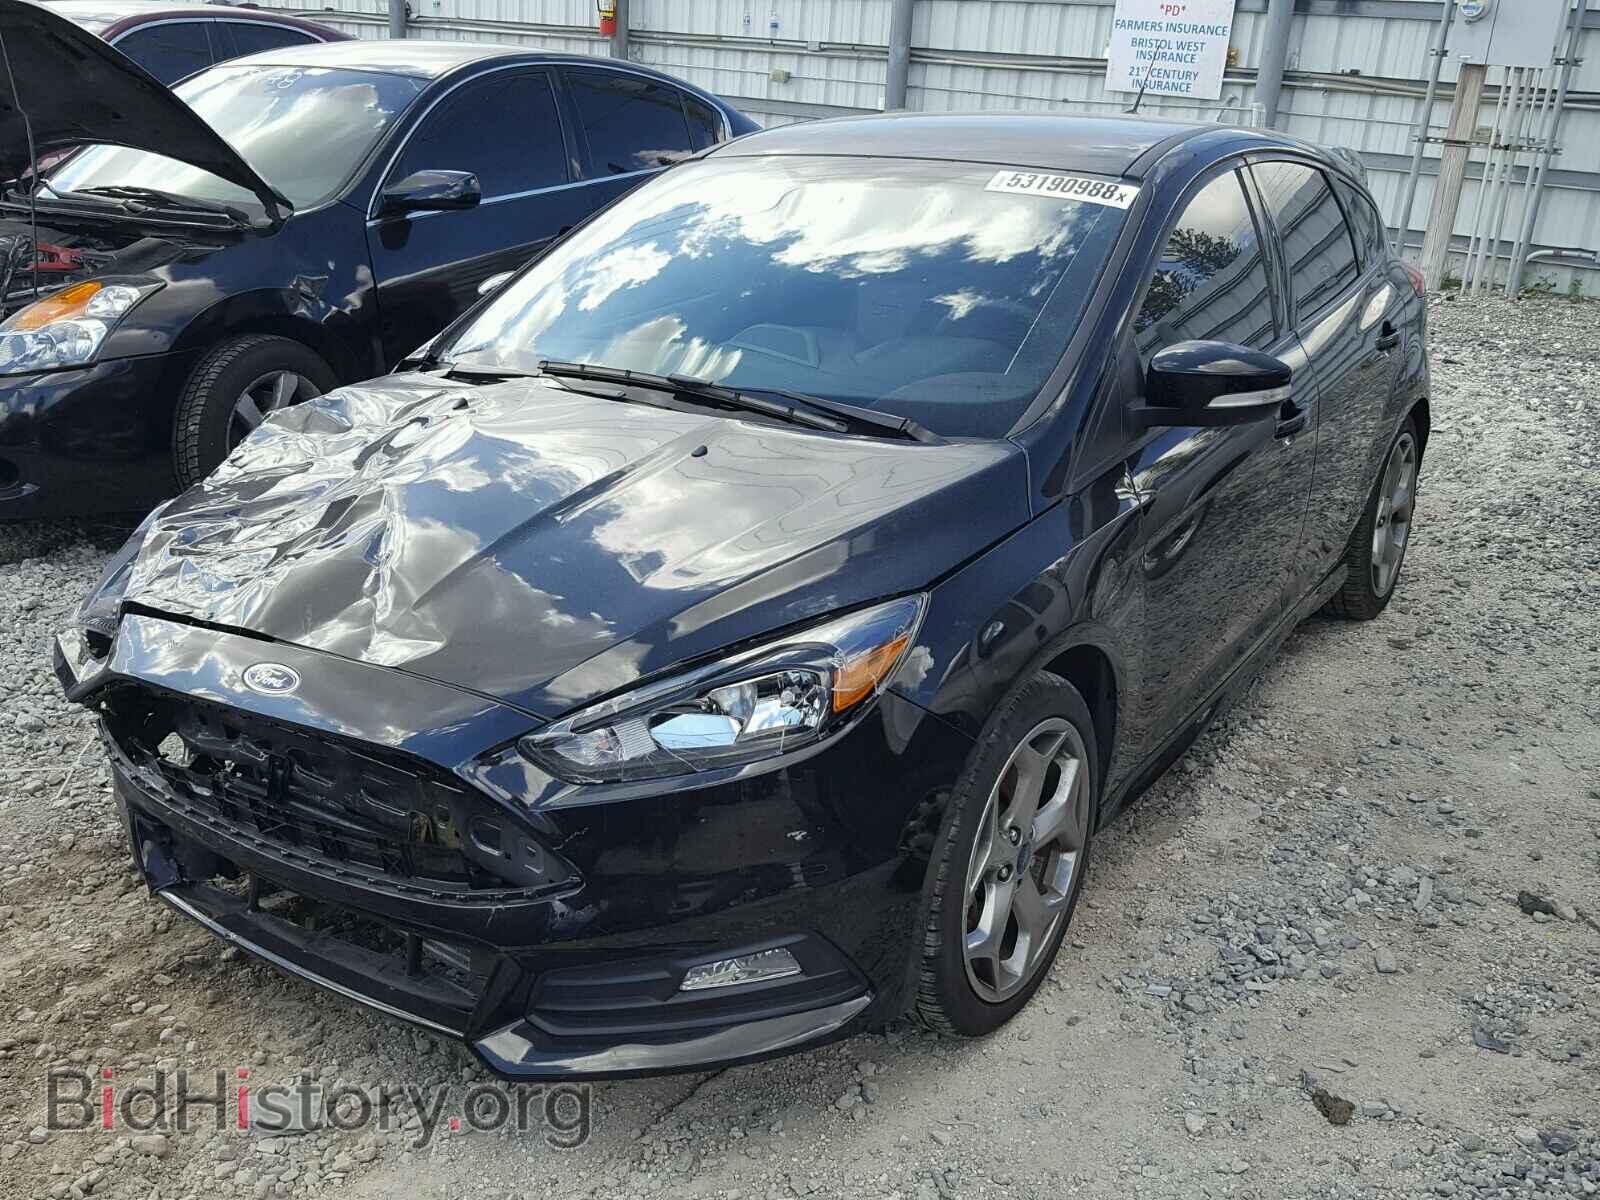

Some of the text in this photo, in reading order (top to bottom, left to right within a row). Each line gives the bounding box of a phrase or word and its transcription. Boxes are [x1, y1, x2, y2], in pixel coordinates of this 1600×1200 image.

[1114, 19, 1229, 36] FARMERS INSURANCE
[1130, 37, 1206, 51] BRISTOL WEST
[1135, 50, 1197, 64] INSURANCE
[1150, 67, 1199, 80] CENTURY
[1131, 79, 1192, 93] INSURANCE
[250, 667, 289, 688] Ford
